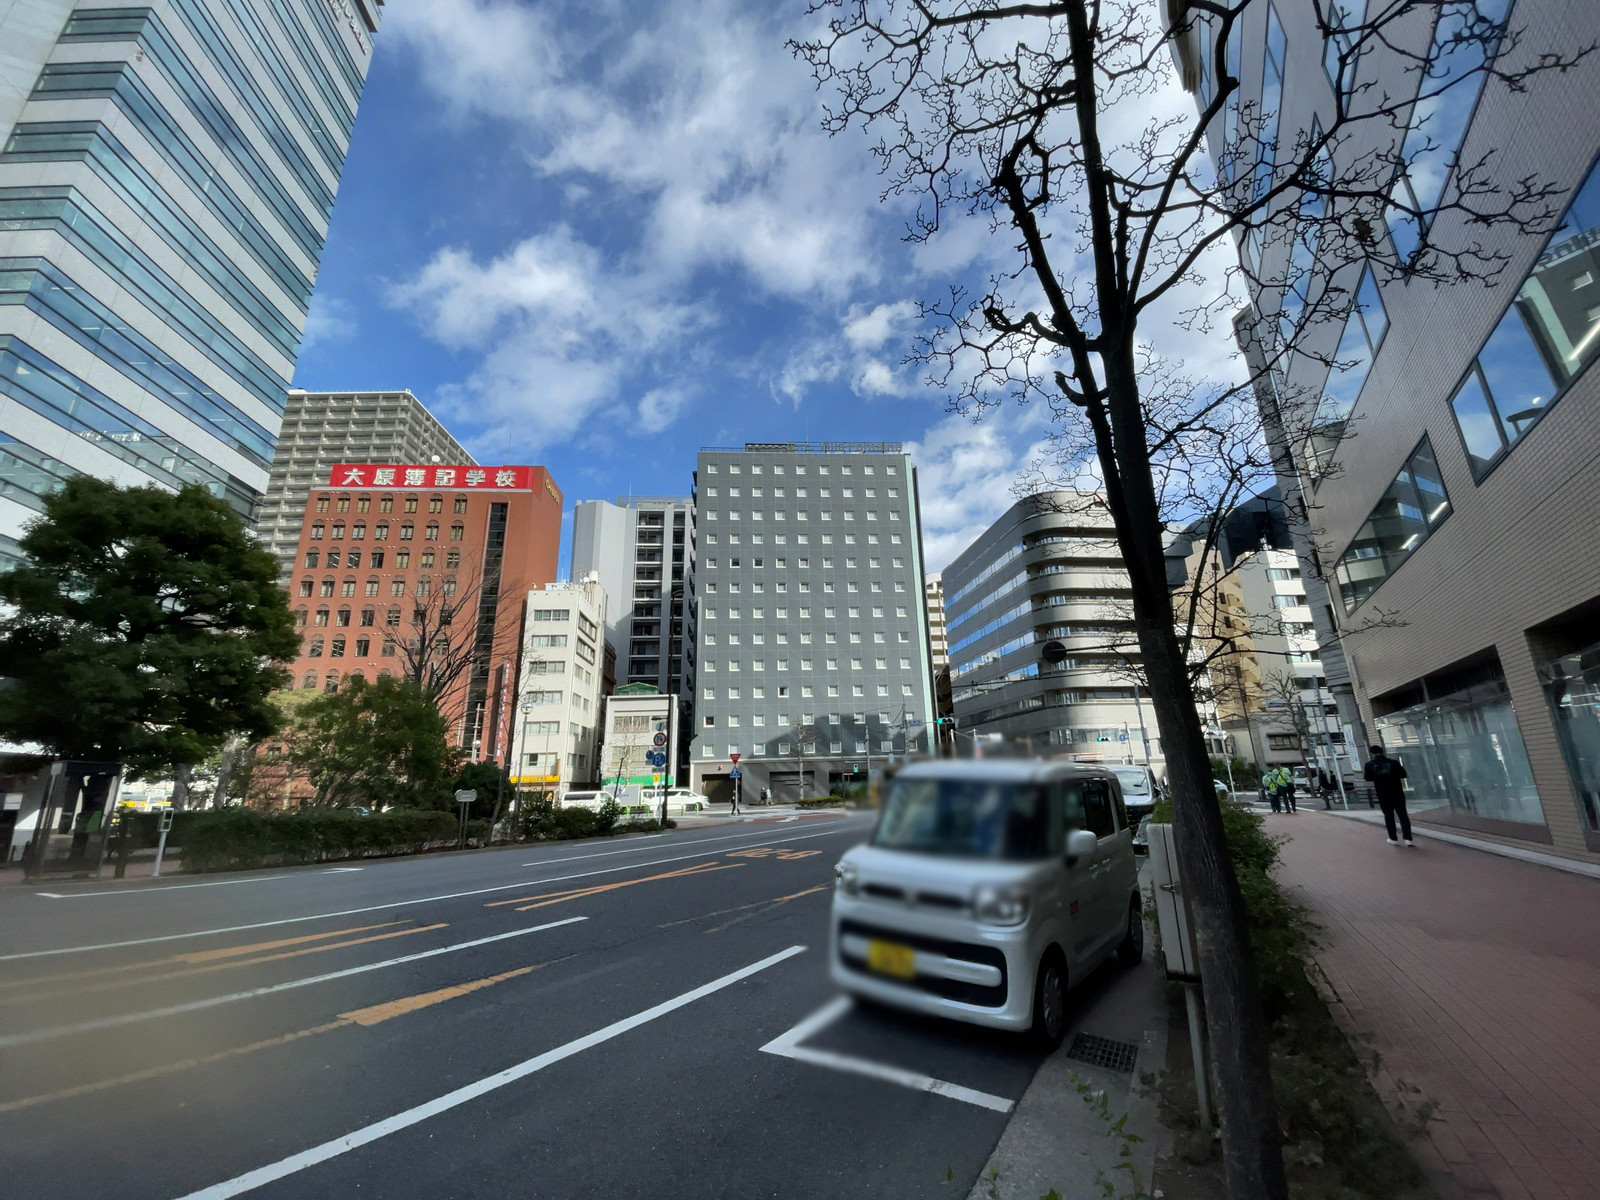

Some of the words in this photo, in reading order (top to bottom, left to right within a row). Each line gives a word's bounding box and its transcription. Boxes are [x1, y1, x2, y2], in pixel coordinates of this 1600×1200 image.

[342, 468, 516, 487] 大原簿記学校
